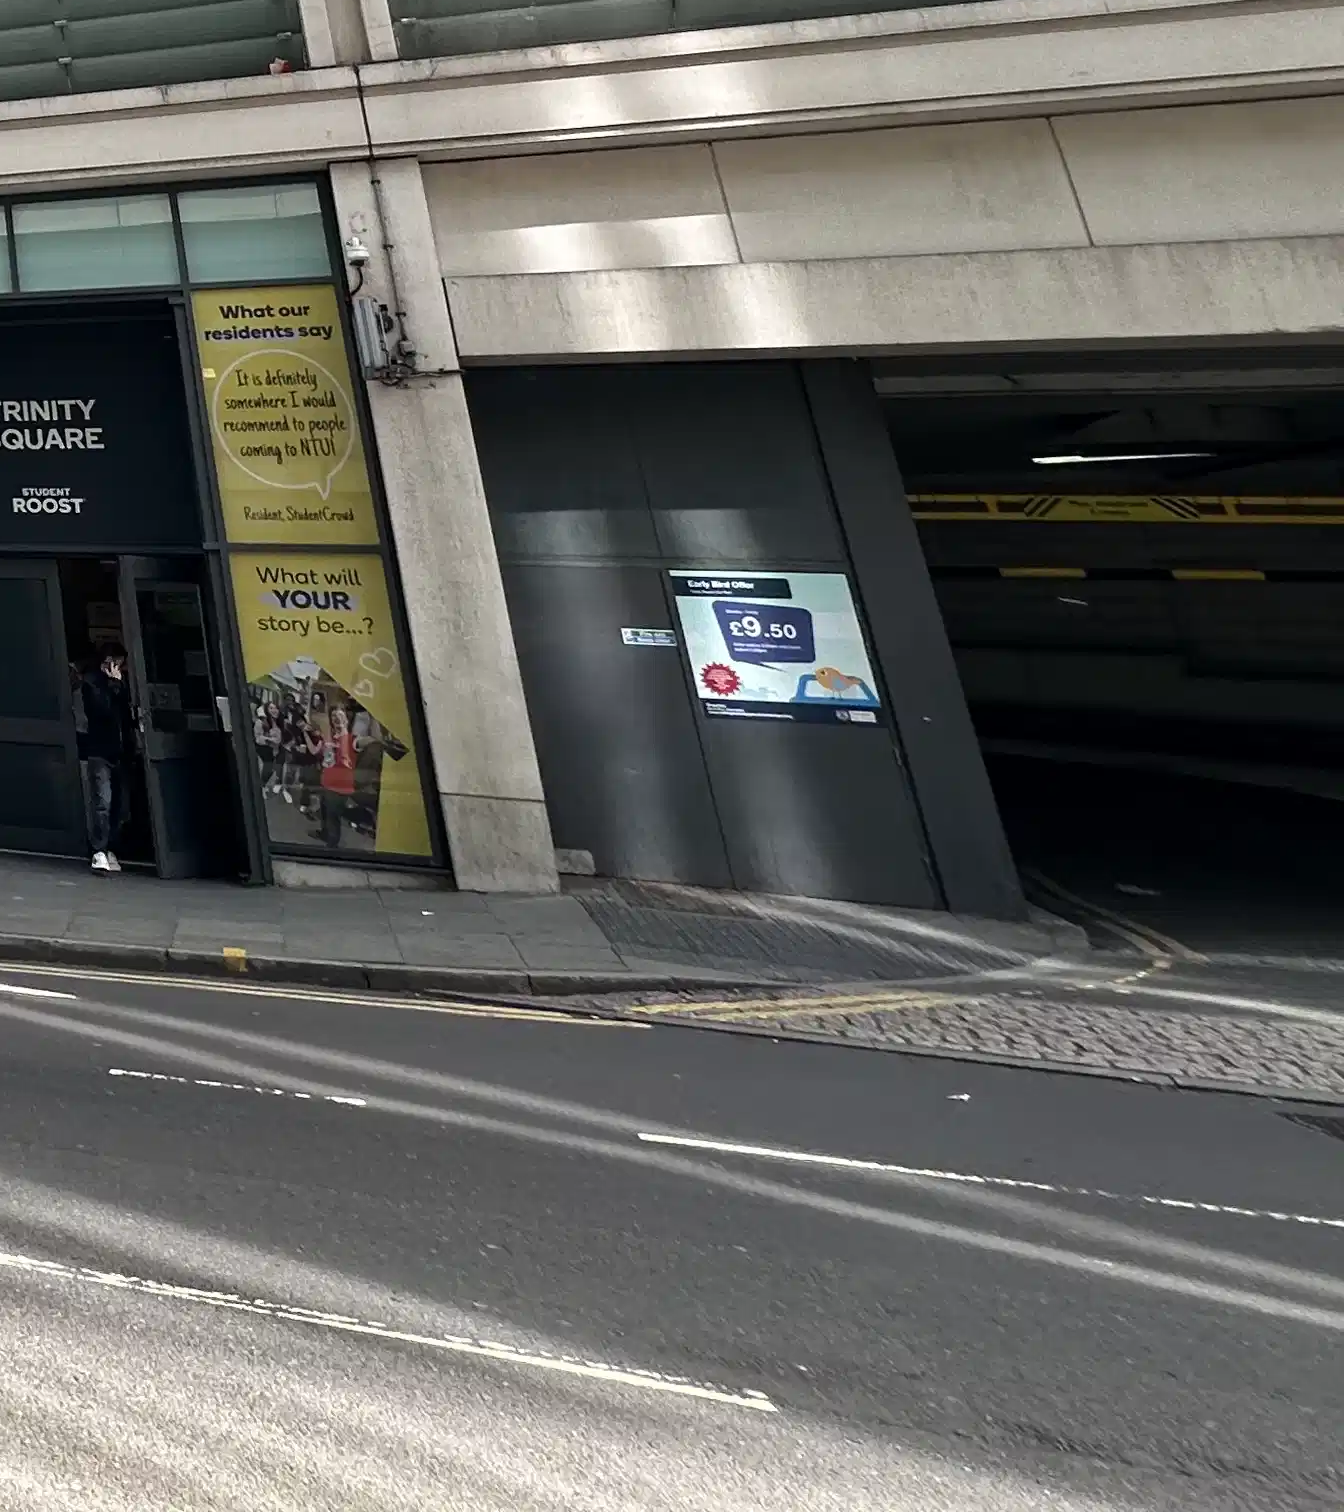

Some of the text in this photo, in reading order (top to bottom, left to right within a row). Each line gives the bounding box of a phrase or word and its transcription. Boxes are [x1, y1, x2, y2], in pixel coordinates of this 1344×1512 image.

[219, 304, 312, 319] What our
[204, 325, 333, 341] residents say
[236, 368, 318, 391] It is definitely
[224, 391, 336, 410] somewhere I would
[224, 413, 348, 438] recommend to people
[240, 443, 283, 464] coming
[285, 443, 297, 457] to
[22, 487, 71, 497] STUDENT
[12, 497, 84, 514] ROOST
[244, 506, 355, 522] Resident, StudentCrowd
[256, 566, 362, 586] What will
[272, 589, 352, 611] YOUR
[257, 615, 374, 637] story be...?
[729, 616, 797, 639] £9.50
